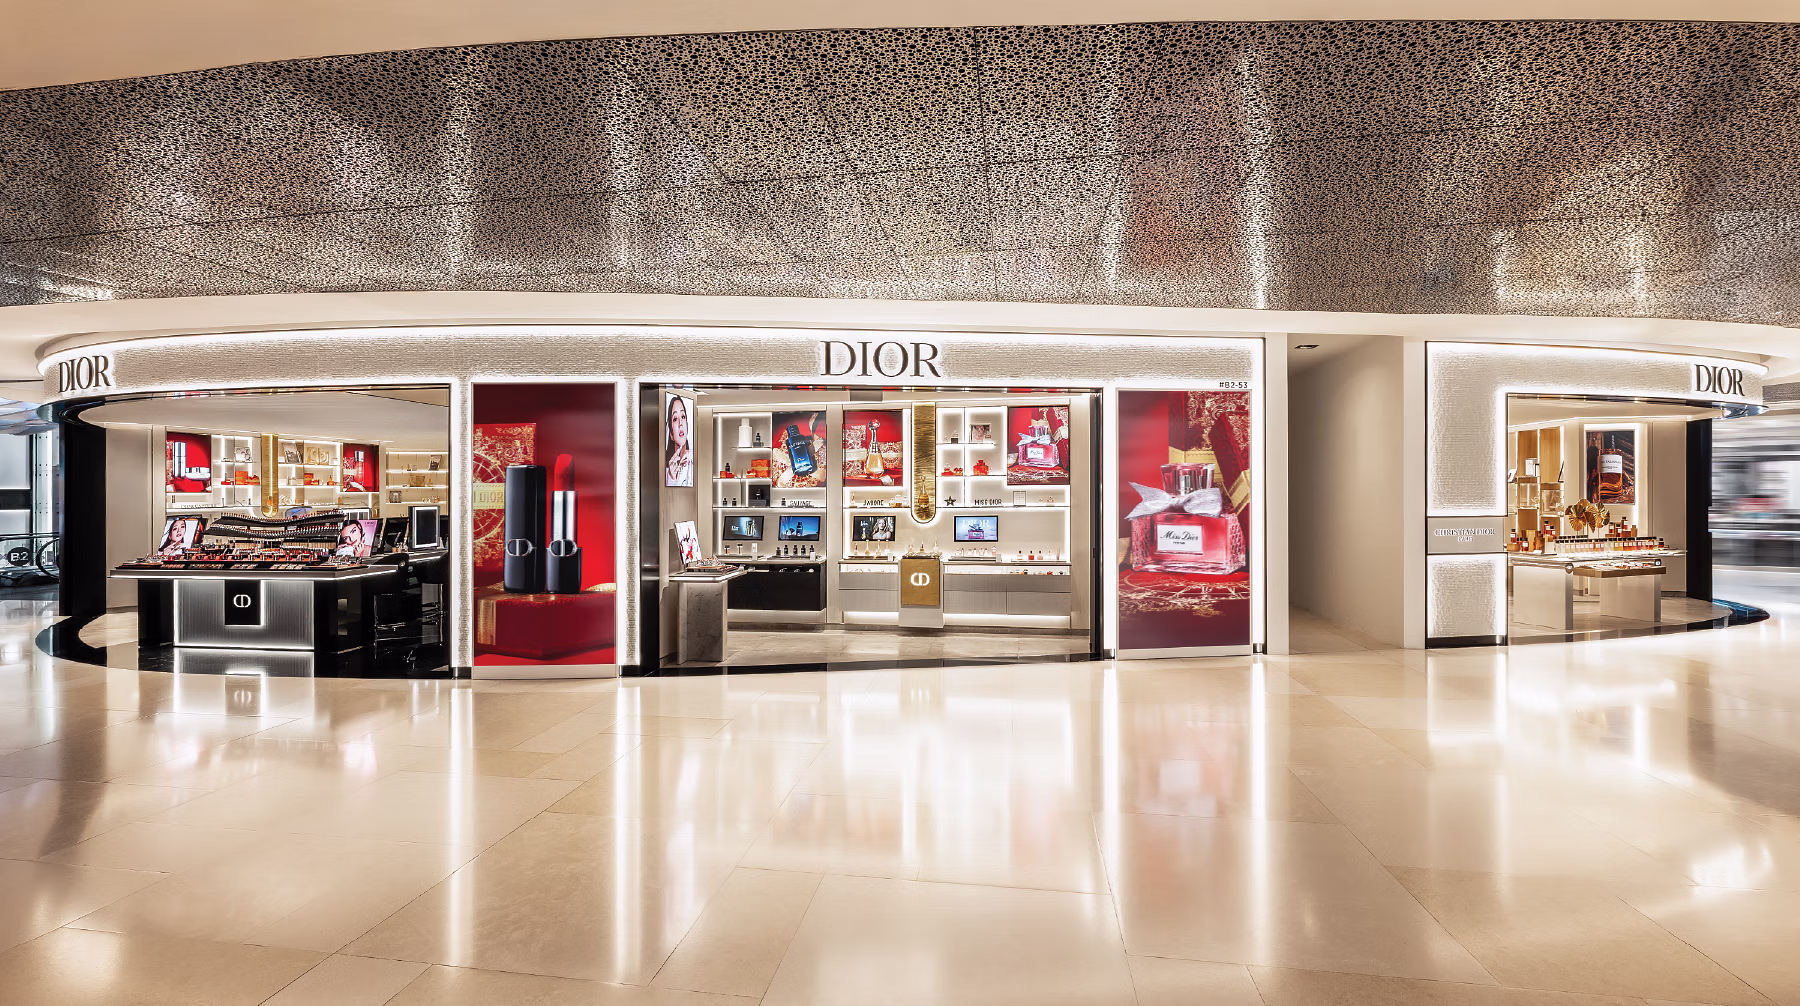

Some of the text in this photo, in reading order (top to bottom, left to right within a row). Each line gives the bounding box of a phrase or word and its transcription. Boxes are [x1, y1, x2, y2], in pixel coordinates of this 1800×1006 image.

[820, 341, 941, 378] DIOR
[58, 355, 112, 393] DIOR
[1219, 381, 1248, 389] #B2-53
[1694, 364, 1746, 397] DIOR
[480, 491, 504, 503] DIOR
[989, 498, 1003, 506] DIOR
[1181, 530, 1199, 541] Dior
[1433, 528, 1495, 537] CHRISTIAN DIOR
[10, 551, 29, 562] B2
